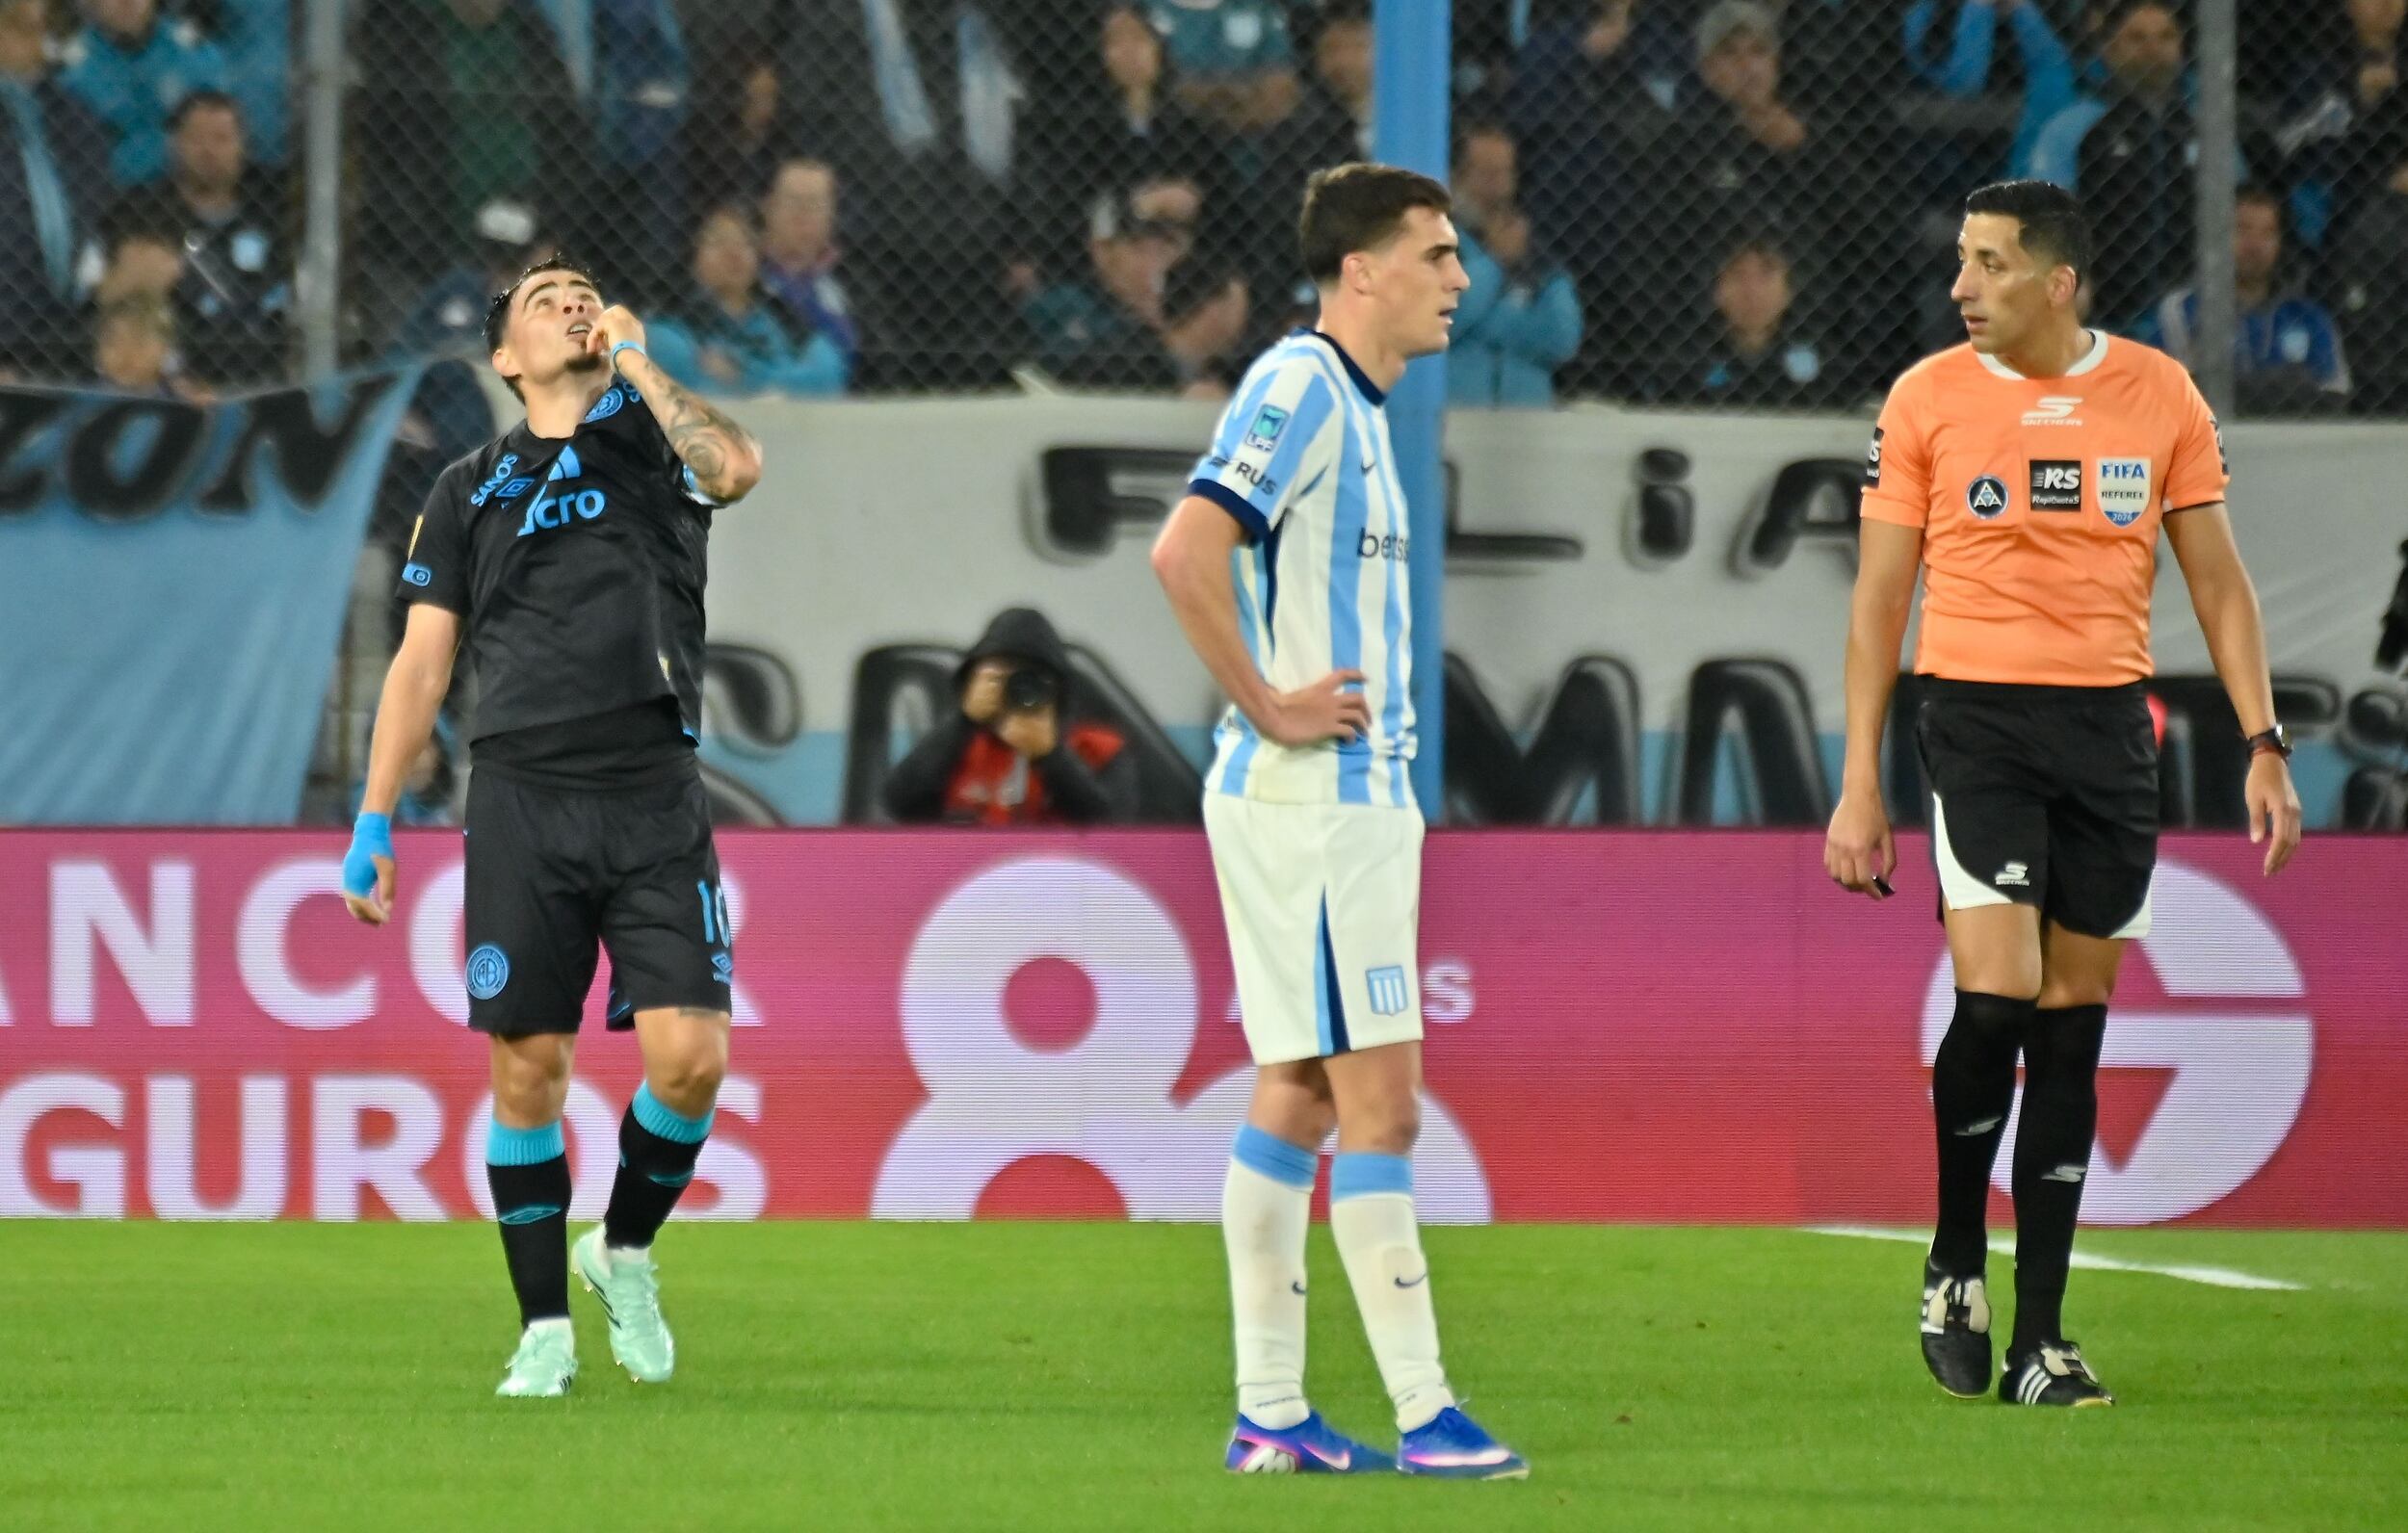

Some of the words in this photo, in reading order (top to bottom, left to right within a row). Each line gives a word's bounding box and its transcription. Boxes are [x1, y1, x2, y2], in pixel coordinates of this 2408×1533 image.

[2044, 468, 2081, 490] RS
[2101, 462, 2145, 479] FIFA
[2102, 490, 2144, 499] REFEREE
[699, 879, 731, 948] 10
